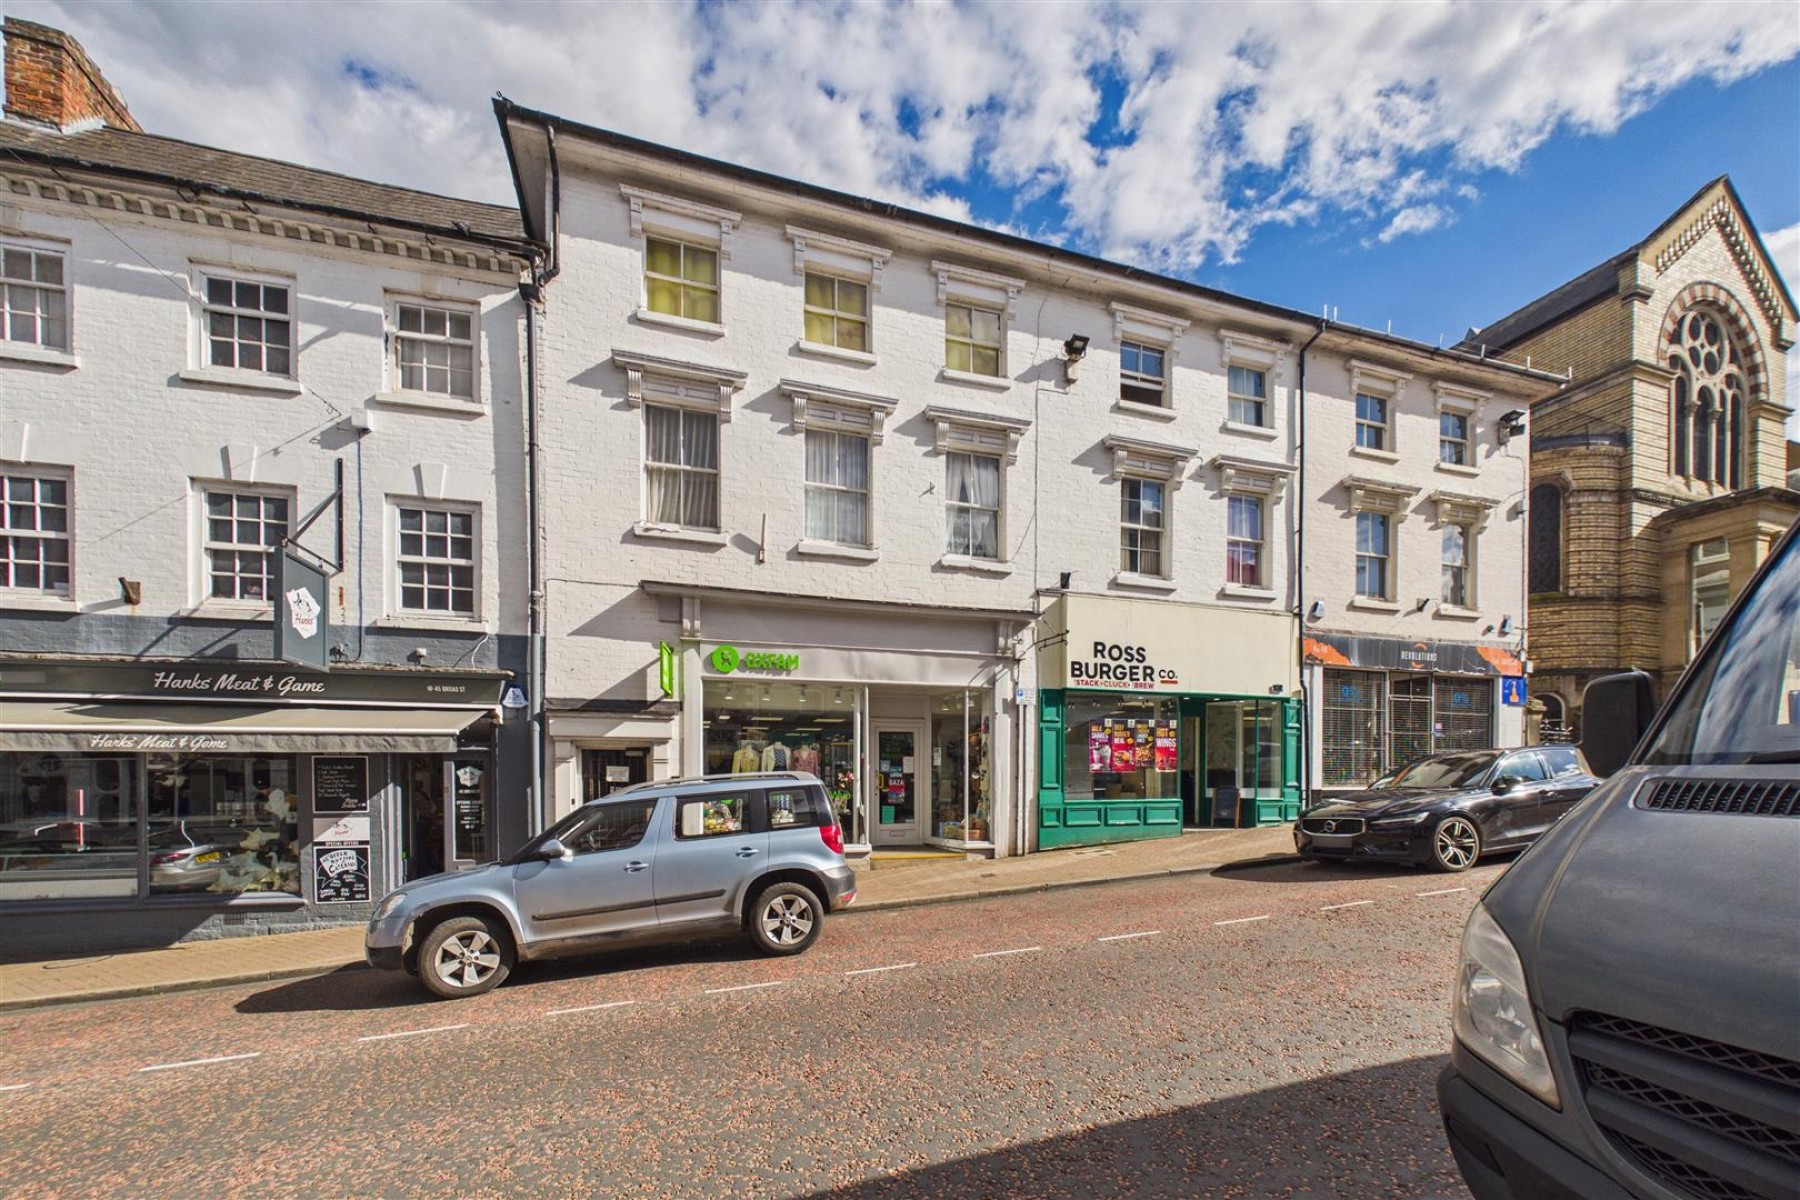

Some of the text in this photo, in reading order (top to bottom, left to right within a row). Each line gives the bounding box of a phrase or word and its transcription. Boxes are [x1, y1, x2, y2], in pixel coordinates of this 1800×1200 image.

[1093, 641, 1146, 663] ROSS
[1401, 650, 1437, 661] REVOLUTIONS
[746, 652, 799, 670] OXFAM
[1070, 661, 1178, 681] BURGER CO.
[213, 673, 261, 691] Meat
[263, 675, 274, 690] &
[278, 675, 325, 696] Game
[1076, 679, 1099, 687] STACK
[1156, 728, 1169, 737] HOT
[136, 735, 178, 749] Meat
[179, 736, 188, 748] &
[190, 736, 227, 752] Game
[1156, 738, 1177, 748] WINGS
